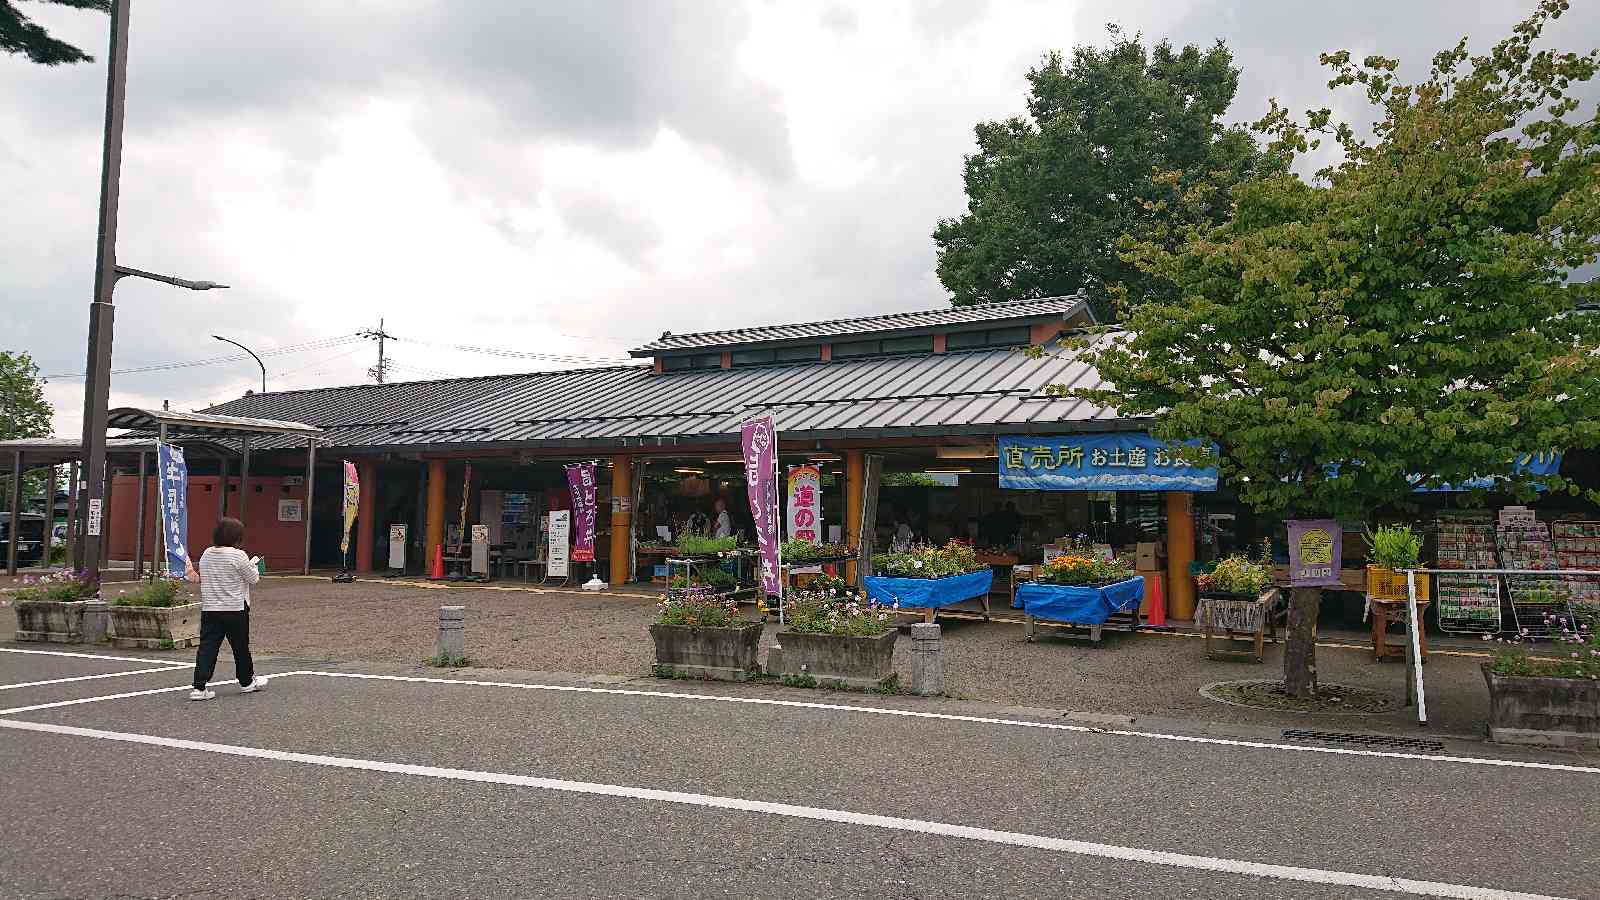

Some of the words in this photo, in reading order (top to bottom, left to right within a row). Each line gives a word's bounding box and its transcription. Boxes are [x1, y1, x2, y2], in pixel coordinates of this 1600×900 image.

[1004, 445, 1084, 470] 直売所
[1091, 447, 1147, 468] お土産
